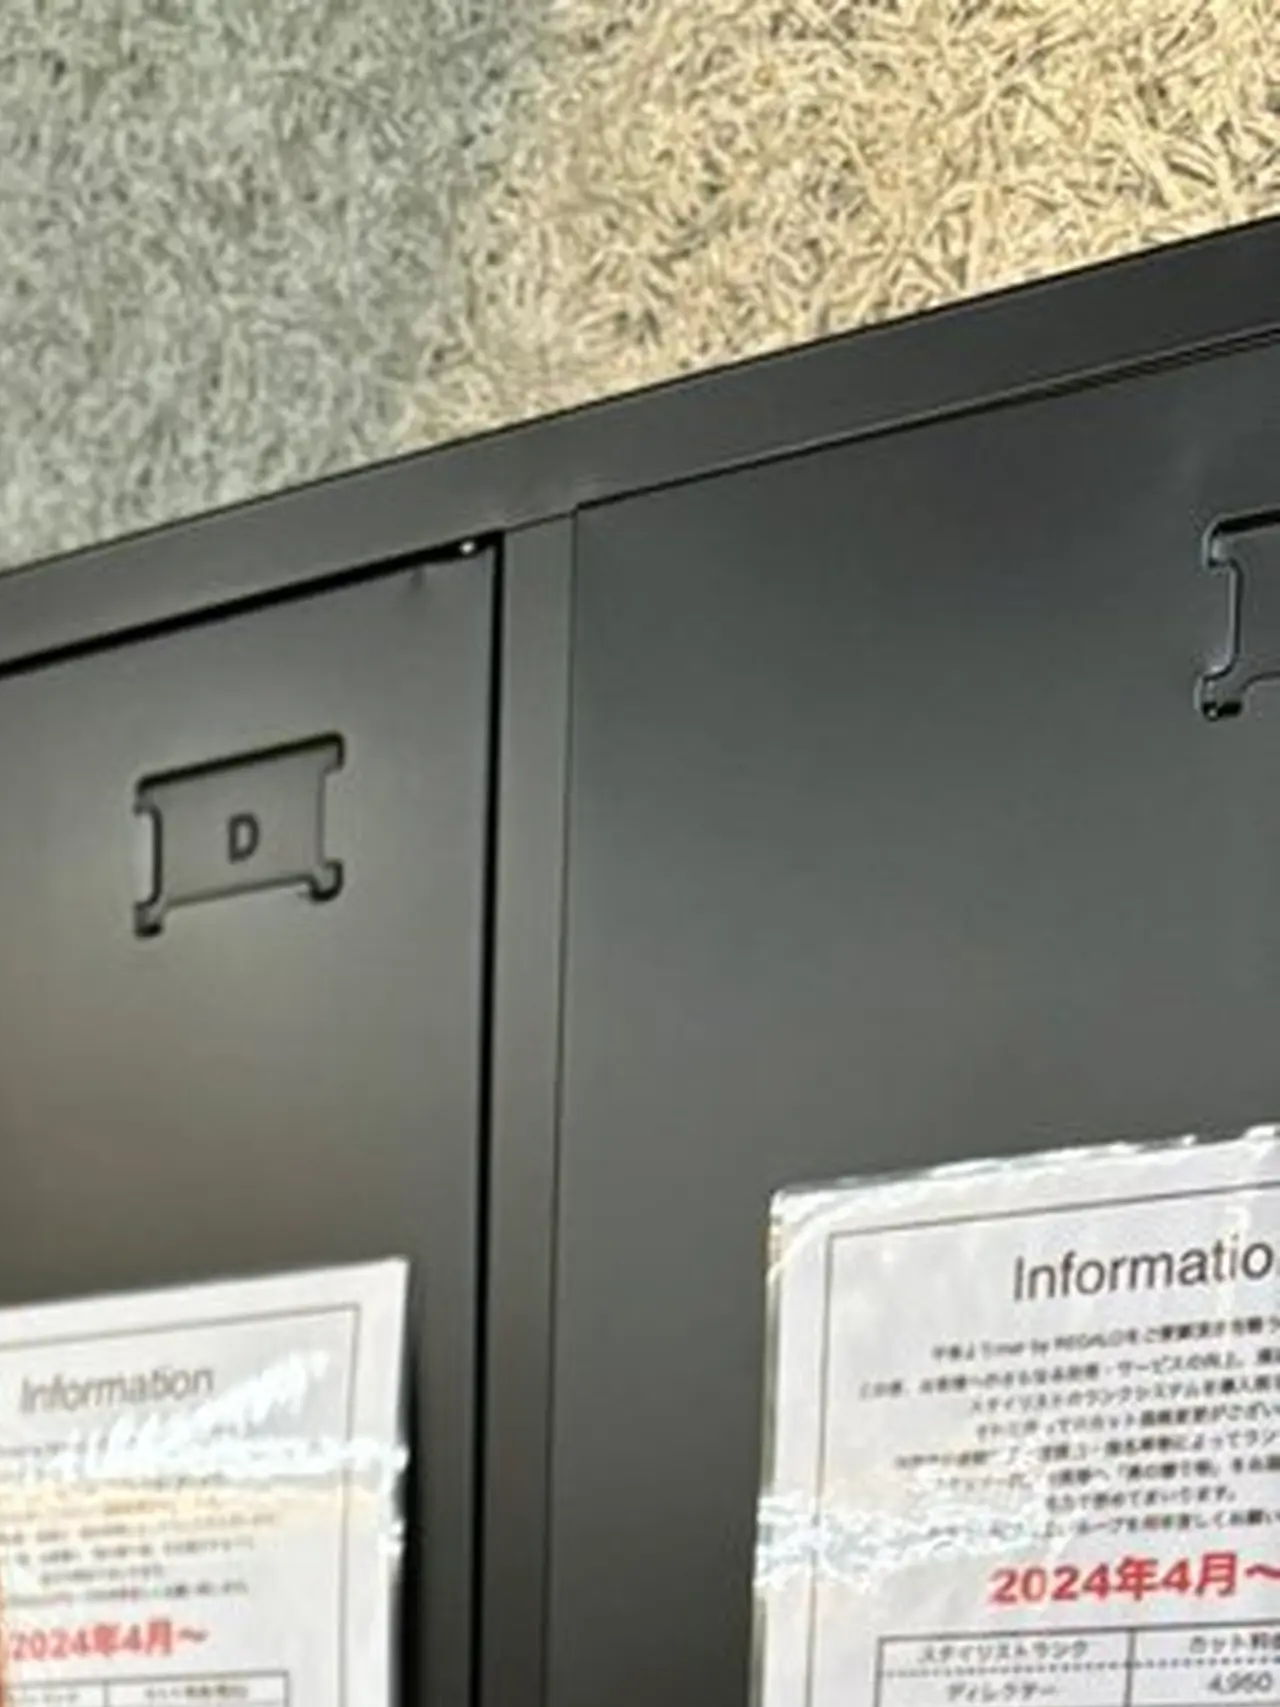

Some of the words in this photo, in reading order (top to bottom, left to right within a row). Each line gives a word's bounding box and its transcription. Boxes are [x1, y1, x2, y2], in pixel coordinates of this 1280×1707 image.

[226, 813, 261, 864] D
[1012, 1232, 1280, 1303] Informatio
[20, 1364, 214, 1417] Information
